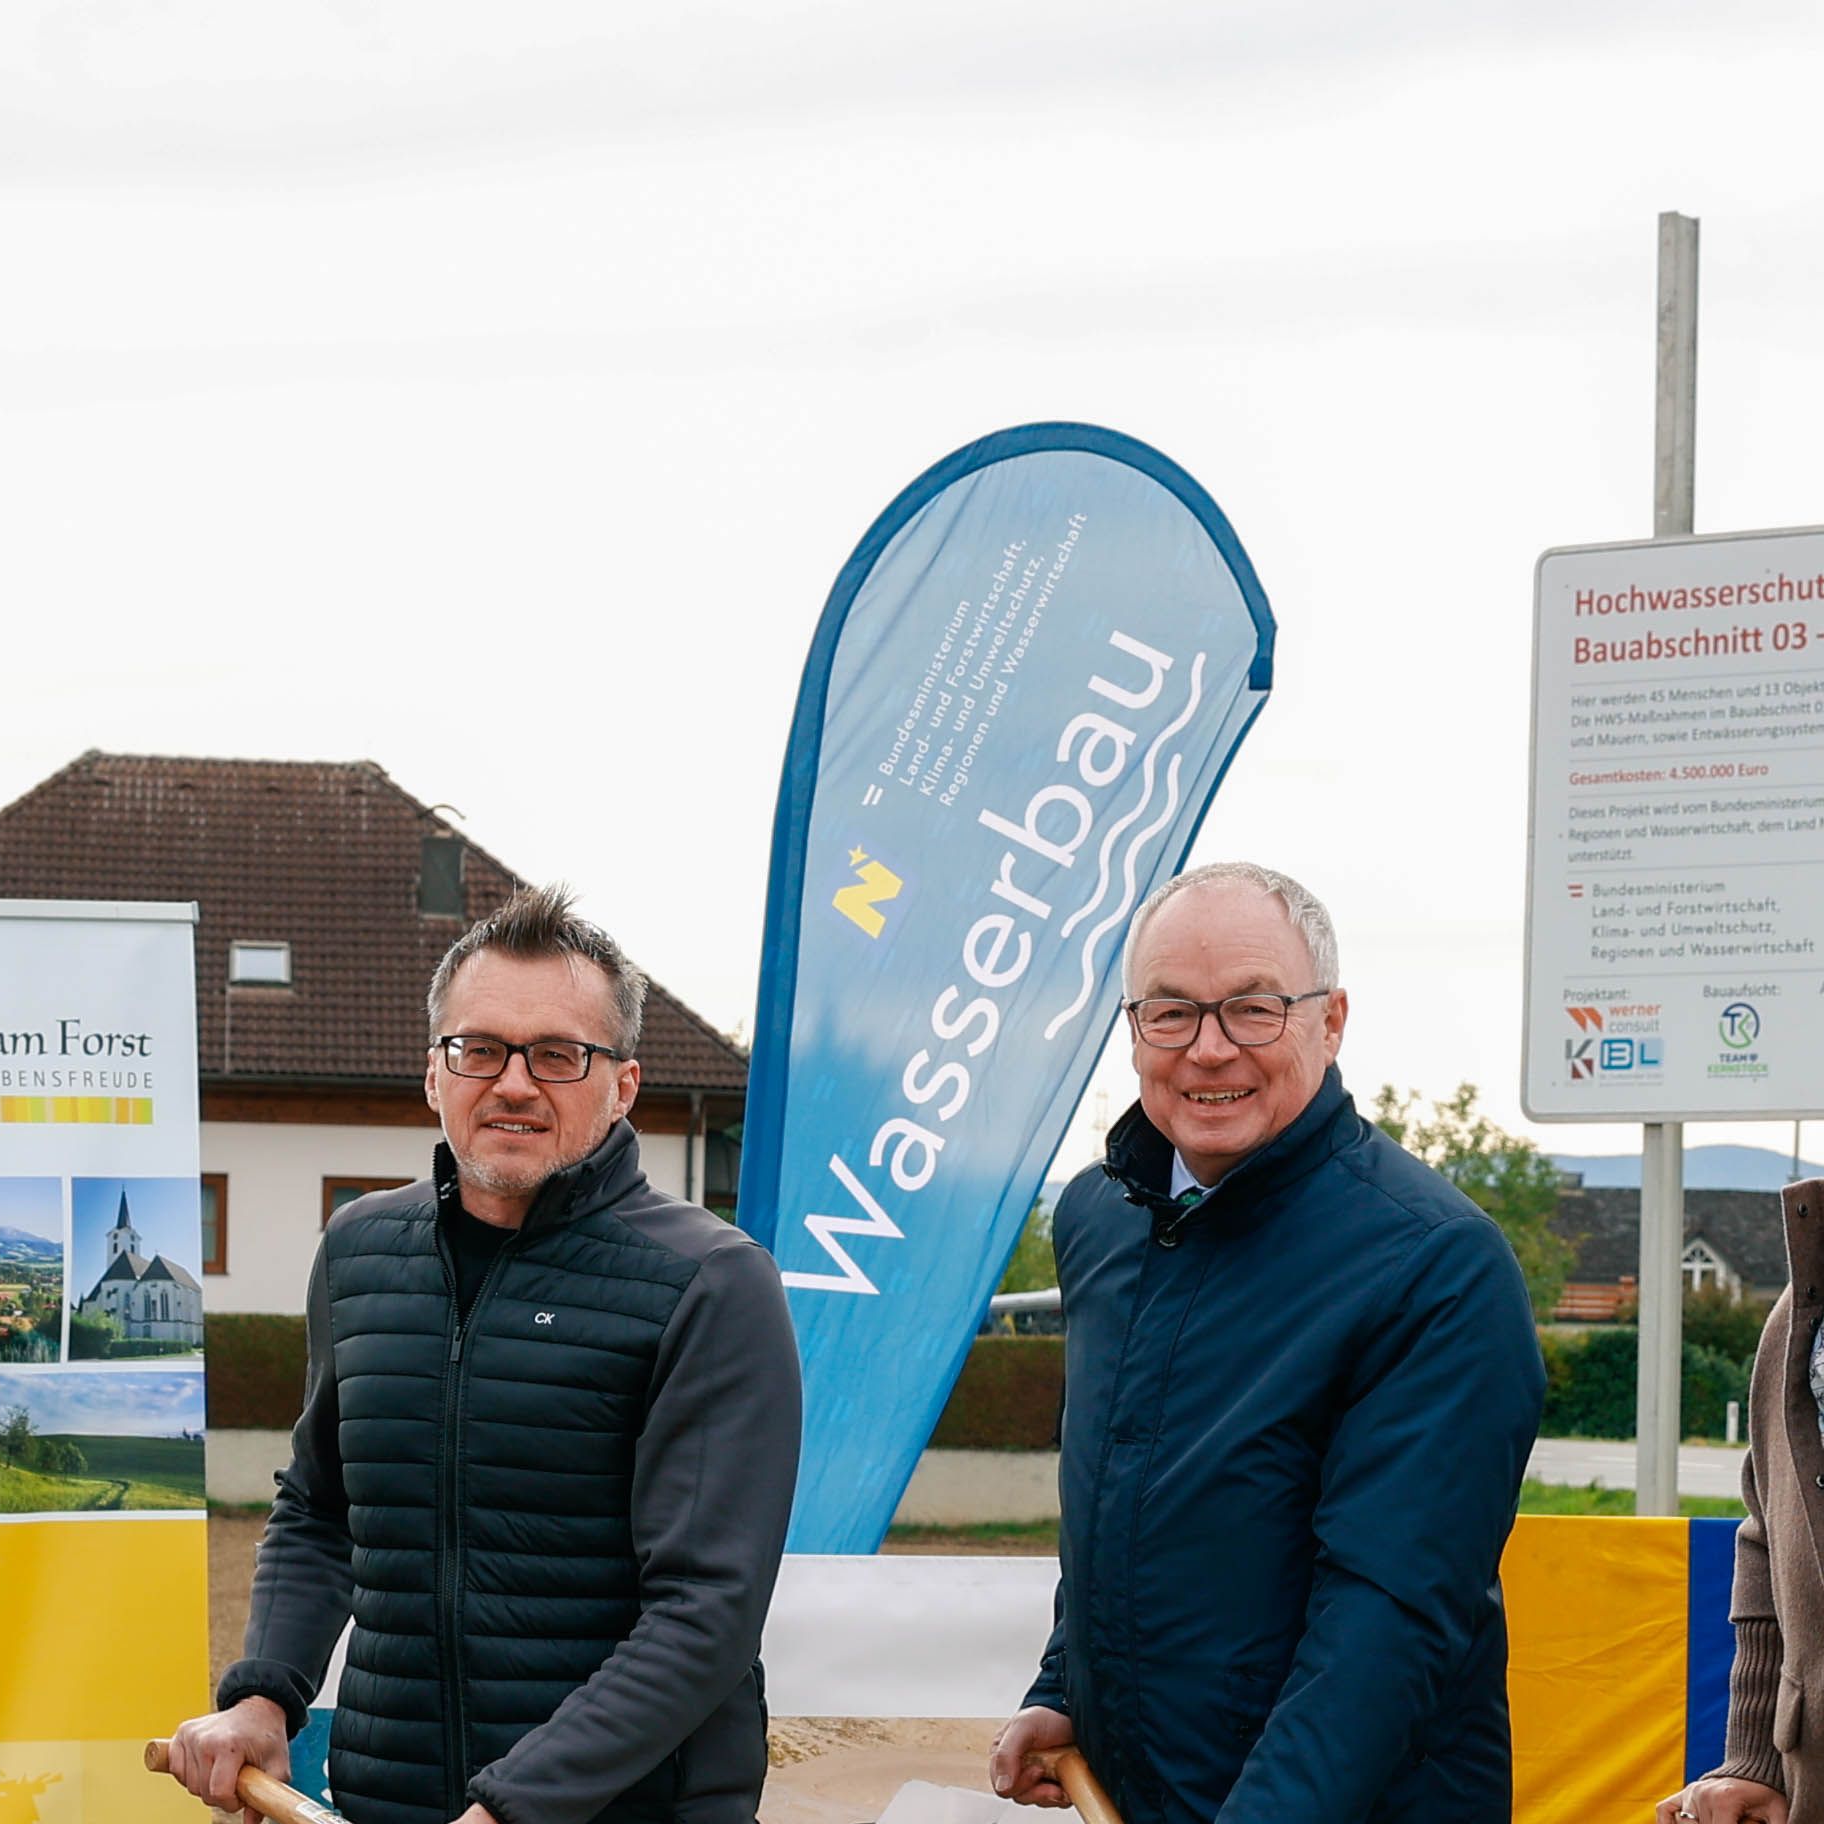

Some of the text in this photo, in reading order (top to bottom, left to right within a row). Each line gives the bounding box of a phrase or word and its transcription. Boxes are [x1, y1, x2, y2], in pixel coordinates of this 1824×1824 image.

[1574, 626, 1763, 664] Bauabschnitt
[1772, 622, 1807, 651] 03
[898, 539, 1027, 786] Land- und Forstwirtschaft,
[939, 512, 1088, 807] Regionen und Wasserwirtschaft
[919, 555, 1046, 797] Klima- und Umweltschutz,
[878, 600, 971, 776] Bundesministerium
[1571, 696, 1596, 707] Hier
[1601, 692, 1646, 706] werden
[1649, 690, 1665, 703] 45
[1669, 688, 1733, 701] Menschen
[1736, 684, 1761, 698] und
[1765, 682, 1780, 696] 13
[1571, 715, 1591, 728] Die
[1594, 709, 1706, 726] HWS-Maßnahmen
[1710, 709, 1725, 719] im
[1729, 702, 1811, 718] Bauabschnitt
[1570, 734, 1594, 748] und
[1597, 733, 1648, 746] Mauern,
[1652, 732, 1688, 743] sowie
[1569, 763, 1769, 786] Gesamtkosten: 4.500.000 Euro
[1569, 807, 1606, 820] Dieses
[1609, 804, 1650, 819] Projekt
[1653, 803, 1679, 815] wird
[1682, 803, 1708, 814] vom
[1568, 828, 1621, 843] Regionen
[1624, 826, 1647, 839] und
[1650, 820, 1754, 837] Wasserwirtschaft,
[1757, 820, 1784, 832] dem
[1787, 817, 1816, 832] Land
[1568, 849, 1633, 863] unterstützt.
[1592, 881, 1725, 897] Bundesministerium
[1592, 900, 1780, 918] Land- und Forstwirtschaft,
[1592, 921, 1775, 938] Klima- und Umweltschutz,
[780, 629, 1174, 1295] Wasserbau
[1592, 940, 1814, 962] Regionen und Wasserwirtschaft
[1563, 989, 1630, 1004] Projektant:
[1703, 984, 1781, 998] Bauaufsicht:
[1609, 1004, 1661, 1017] werner
[56, 1018, 153, 1057] Forst
[1609, 1020, 1660, 1033] consult
[535, 1312, 556, 1325] CK
